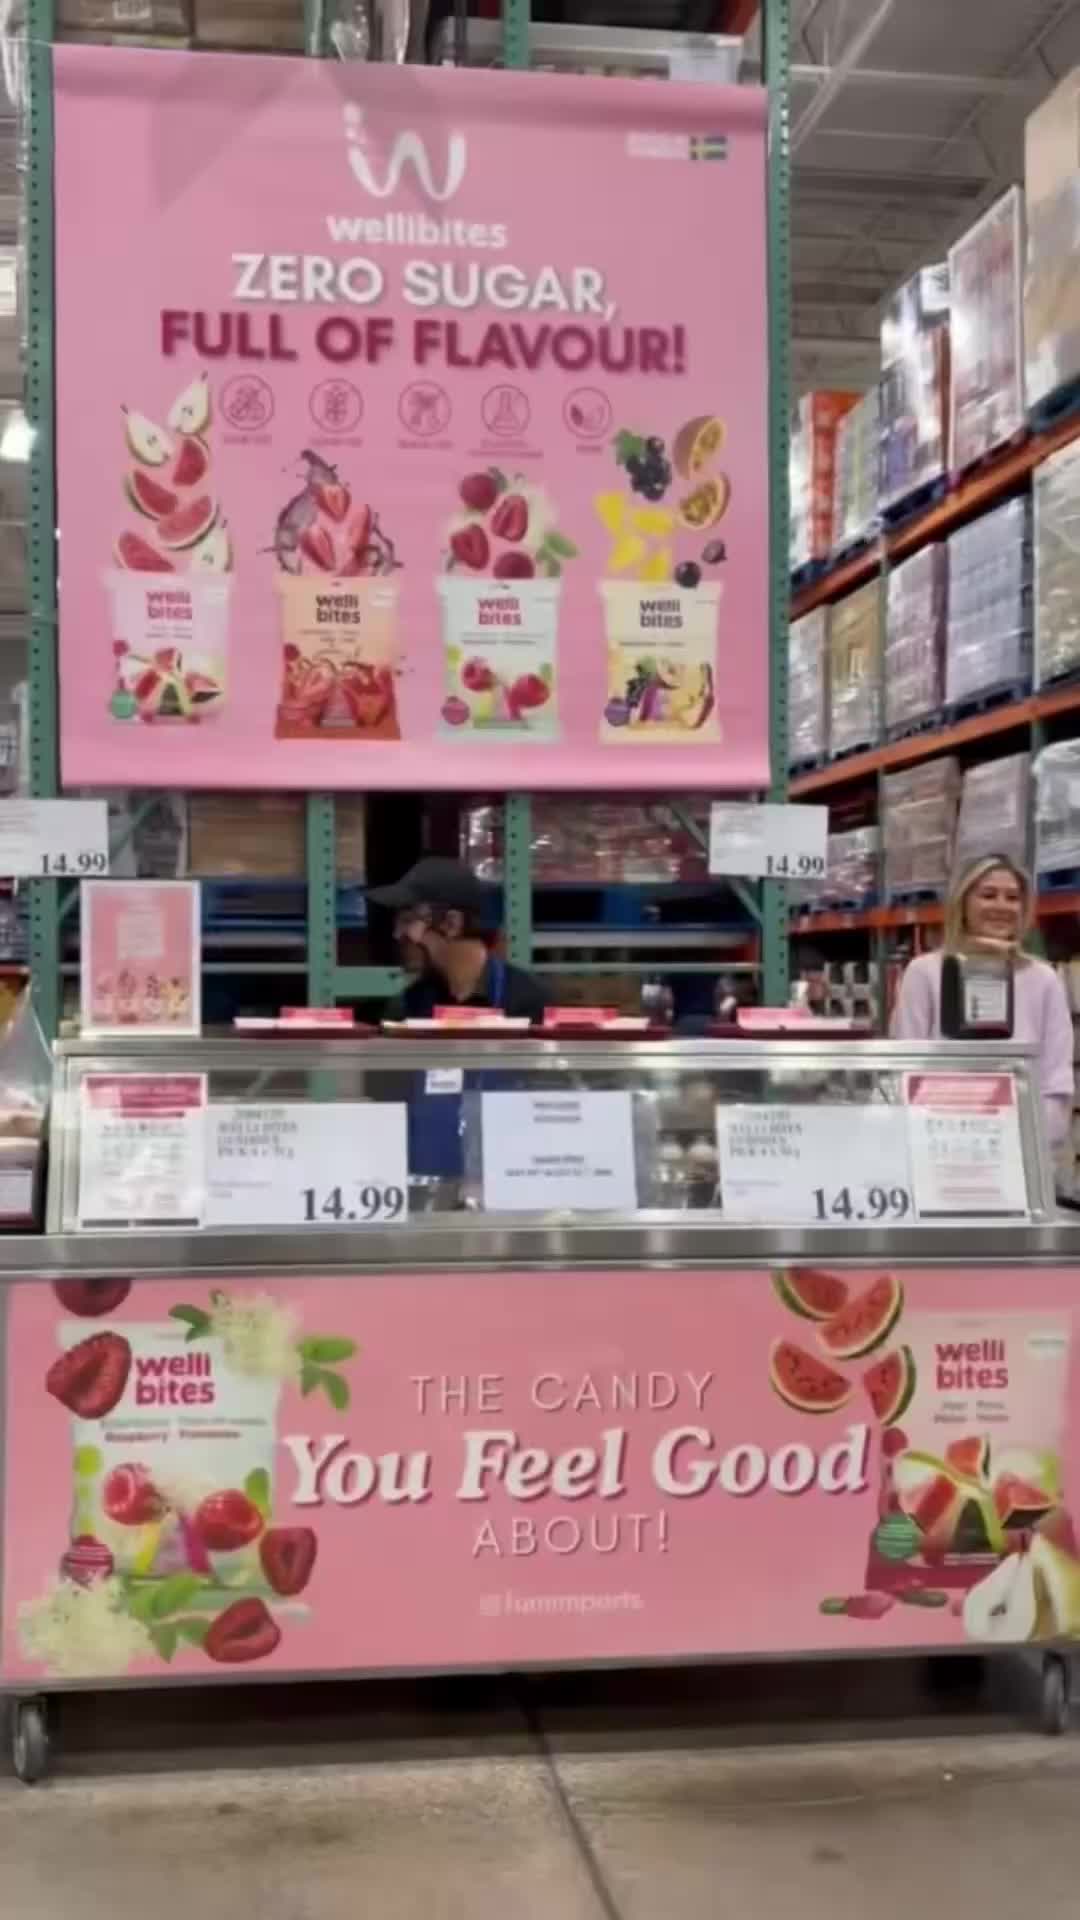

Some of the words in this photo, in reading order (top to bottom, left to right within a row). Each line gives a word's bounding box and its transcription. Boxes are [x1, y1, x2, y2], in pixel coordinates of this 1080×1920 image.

[326, 213, 508, 249] wellibites
[231, 252, 383, 304] ZERO
[401, 259, 617, 320] SUGAR,
[161, 310, 298, 362] FULL
[315, 316, 395, 364] OF
[412, 319, 687, 374] FLAVOUR!
[146, 590, 192, 605] welli
[315, 593, 360, 608] welli
[477, 597, 521, 611] welli
[639, 599, 681, 612] welli
[147, 606, 193, 620] bites
[316, 608, 361, 624] bites
[478, 611, 522, 626] bites
[640, 613, 684, 628] bites
[41, 852, 106, 873] 14.99
[766, 853, 825, 876] 14.99
[302, 1186, 405, 1221] 14.99
[811, 1186, 910, 1220] 14.99
[935, 1339, 1006, 1362] welli
[135, 1352, 212, 1377] welli
[935, 1365, 1009, 1389] bites
[135, 1380, 215, 1405] bites
[411, 1374, 504, 1414] THE
[530, 1371, 715, 1412] CANDY
[282, 1434, 433, 1506] You
[456, 1427, 626, 1500] Feel
[651, 1424, 872, 1495] Good
[472, 1510, 672, 1558] ABOUT!
